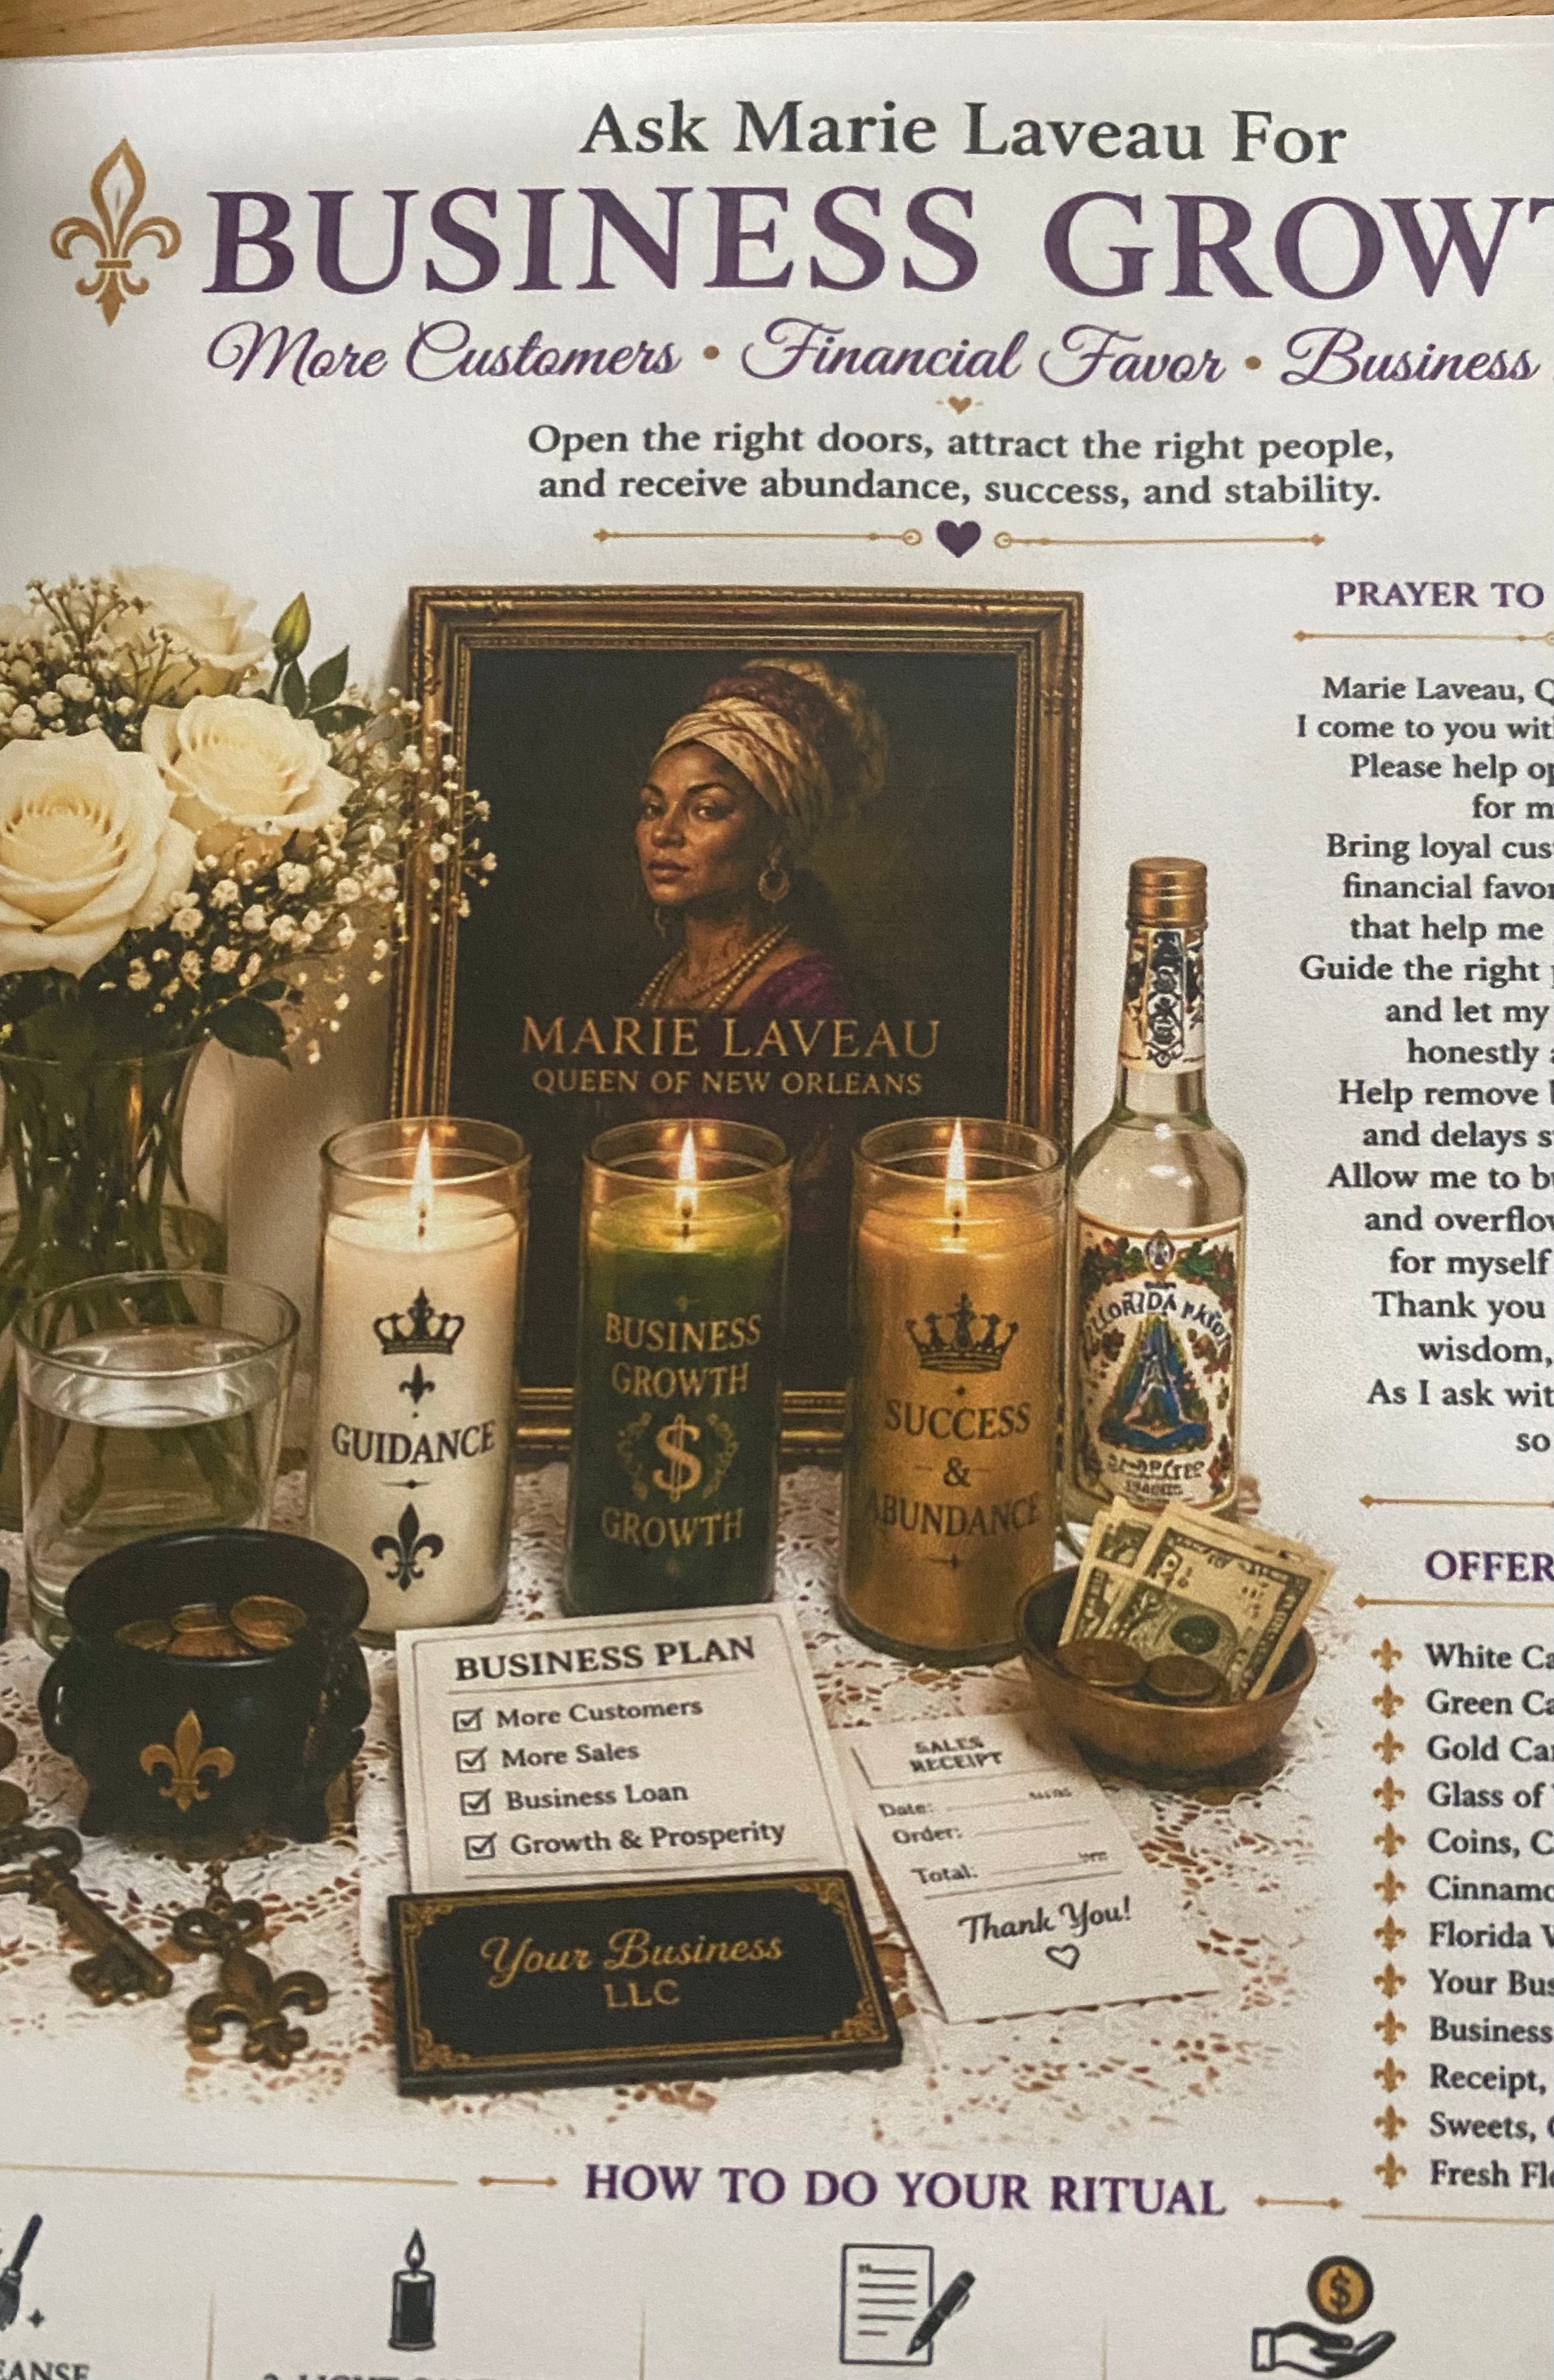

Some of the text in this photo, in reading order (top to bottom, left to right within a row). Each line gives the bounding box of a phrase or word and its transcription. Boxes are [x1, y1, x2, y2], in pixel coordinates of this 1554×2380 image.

[579, 99, 1347, 163] Ask Marie Laveau For
[202, 186, 1554, 300] BUSINESS GROW
[207, 318, 1541, 387] More Customers Financial Favor Business
[529, 422, 1393, 469] Open the right doors, attract the right people,
[539, 467, 1380, 511] and receive abundance, success, and stability.
[1336, 582, 1544, 608] PRAYER TO
[1323, 676, 1406, 699] Marie
[1417, 677, 1524, 704] Laveau,
[1298, 714, 1554, 746] I come to you wit
[1350, 752, 1442, 778] Please
[1453, 754, 1517, 786] help
[1473, 793, 1516, 819] for
[1327, 833, 1552, 865] Bring loyal cus
[1344, 872, 1472, 899] financial
[1350, 913, 1543, 948] that help me
[1300, 954, 1393, 980] Guide
[1404, 955, 1453, 980] the
[1464, 955, 1539, 989] right
[1386, 996, 1549, 1031] and let my
[521, 1016, 940, 1058] MARIE LAVEAU
[1408, 1037, 1539, 1072] honestly
[532, 1068, 922, 1095] QUEEN OF NEW ORLEANS
[1339, 1078, 1412, 1113] Help
[1425, 1087, 1538, 1106] remove
[1363, 1120, 1420, 1146] and
[1431, 1120, 1527, 1155] delays
[1327, 1162, 1418, 1188] Allow
[1430, 1171, 1477, 1189] me
[1488, 1168, 1520, 1190] to
[1365, 1205, 1554, 1232] and overflo
[1390, 1247, 1552, 1282] for myself
[1372, 1290, 1545, 1326] Thank you
[607, 1312, 761, 1353] BUSINESS
[1418, 1334, 1552, 1367] wisdom,
[611, 1361, 748, 1398] GROWTH
[1367, 1379, 1407, 1405] As
[1419, 1380, 1429, 1405] I
[1442, 1378, 1494, 1406] ask
[884, 1399, 1032, 1440] SUCCESS
[332, 1420, 495, 1465] GUIDANCE
[1516, 1433, 1550, 1452] so
[944, 1457, 970, 1487] &
[601, 1507, 743, 1549] GROWTH
[867, 1489, 1040, 1536] ABUNDANCE
[1425, 1550, 1554, 1581] OFFER
[456, 1636, 755, 1681] BUSINESS PLAN
[1425, 1643, 1511, 1668] White
[497, 1701, 703, 1728] More Customers
[1426, 1688, 1513, 1714] Green
[502, 1743, 639, 1769] More Sales
[1427, 1735, 1554, 1762] Gold Ca
[507, 1784, 688, 1811] Business Loan
[878, 1801, 935, 1818] Date:
[1428, 1781, 1546, 1808] Glass of
[511, 1821, 785, 1855] Growth & Prosperity
[893, 1826, 963, 1845] Order:
[1428, 1828, 1520, 1858] Coins,
[912, 1866, 978, 1885] Total:
[958, 1896, 1130, 1944] Thank You!
[1430, 1920, 1532, 1948] Florida
[480, 1929, 783, 1989] Your Business
[605, 1979, 679, 2009] LLC
[1429, 1969, 1497, 1995] Your
[1430, 2016, 1553, 2043] Business
[1430, 2063, 1546, 2099] Receipt,
[1429, 2111, 1536, 2143] Sweets,
[1431, 2159, 1510, 2187] Fresh
[585, 2164, 1226, 2215] HOW TO DO YOUR RITUAL
